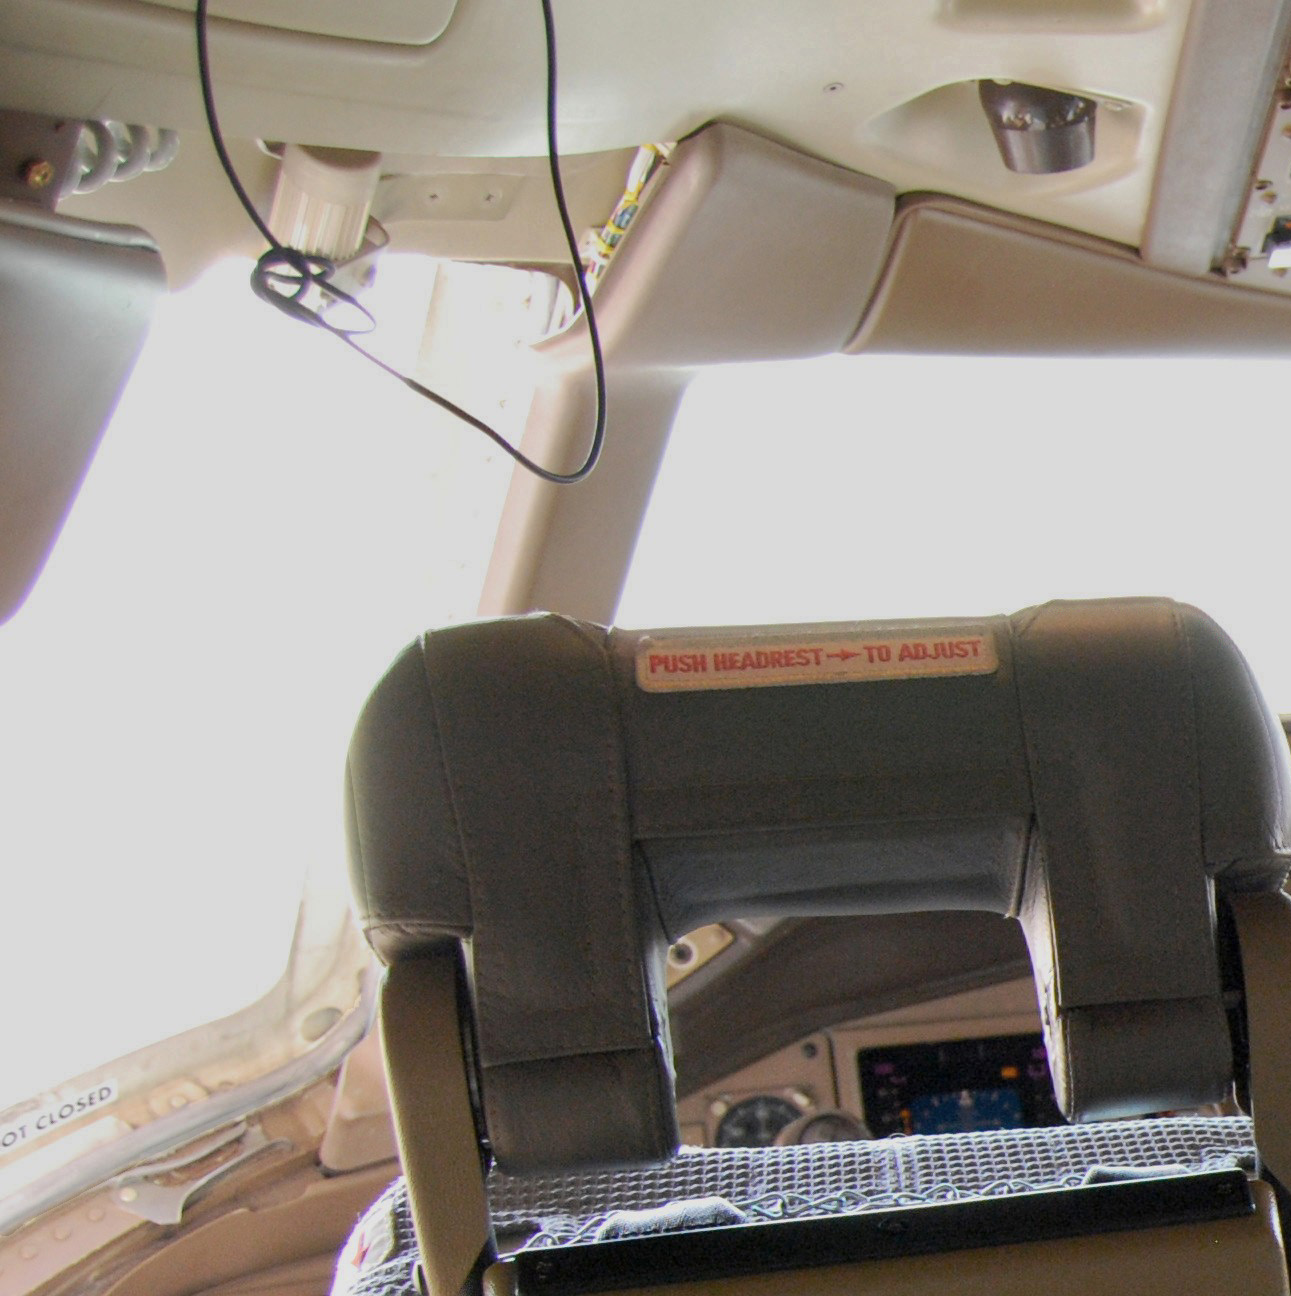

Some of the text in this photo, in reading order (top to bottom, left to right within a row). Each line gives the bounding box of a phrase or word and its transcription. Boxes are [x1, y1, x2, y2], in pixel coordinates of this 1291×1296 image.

[650, 639, 980, 673] PUSH HEADREST TO ADJUST
[36, 1086, 112, 1130] CLOSED
